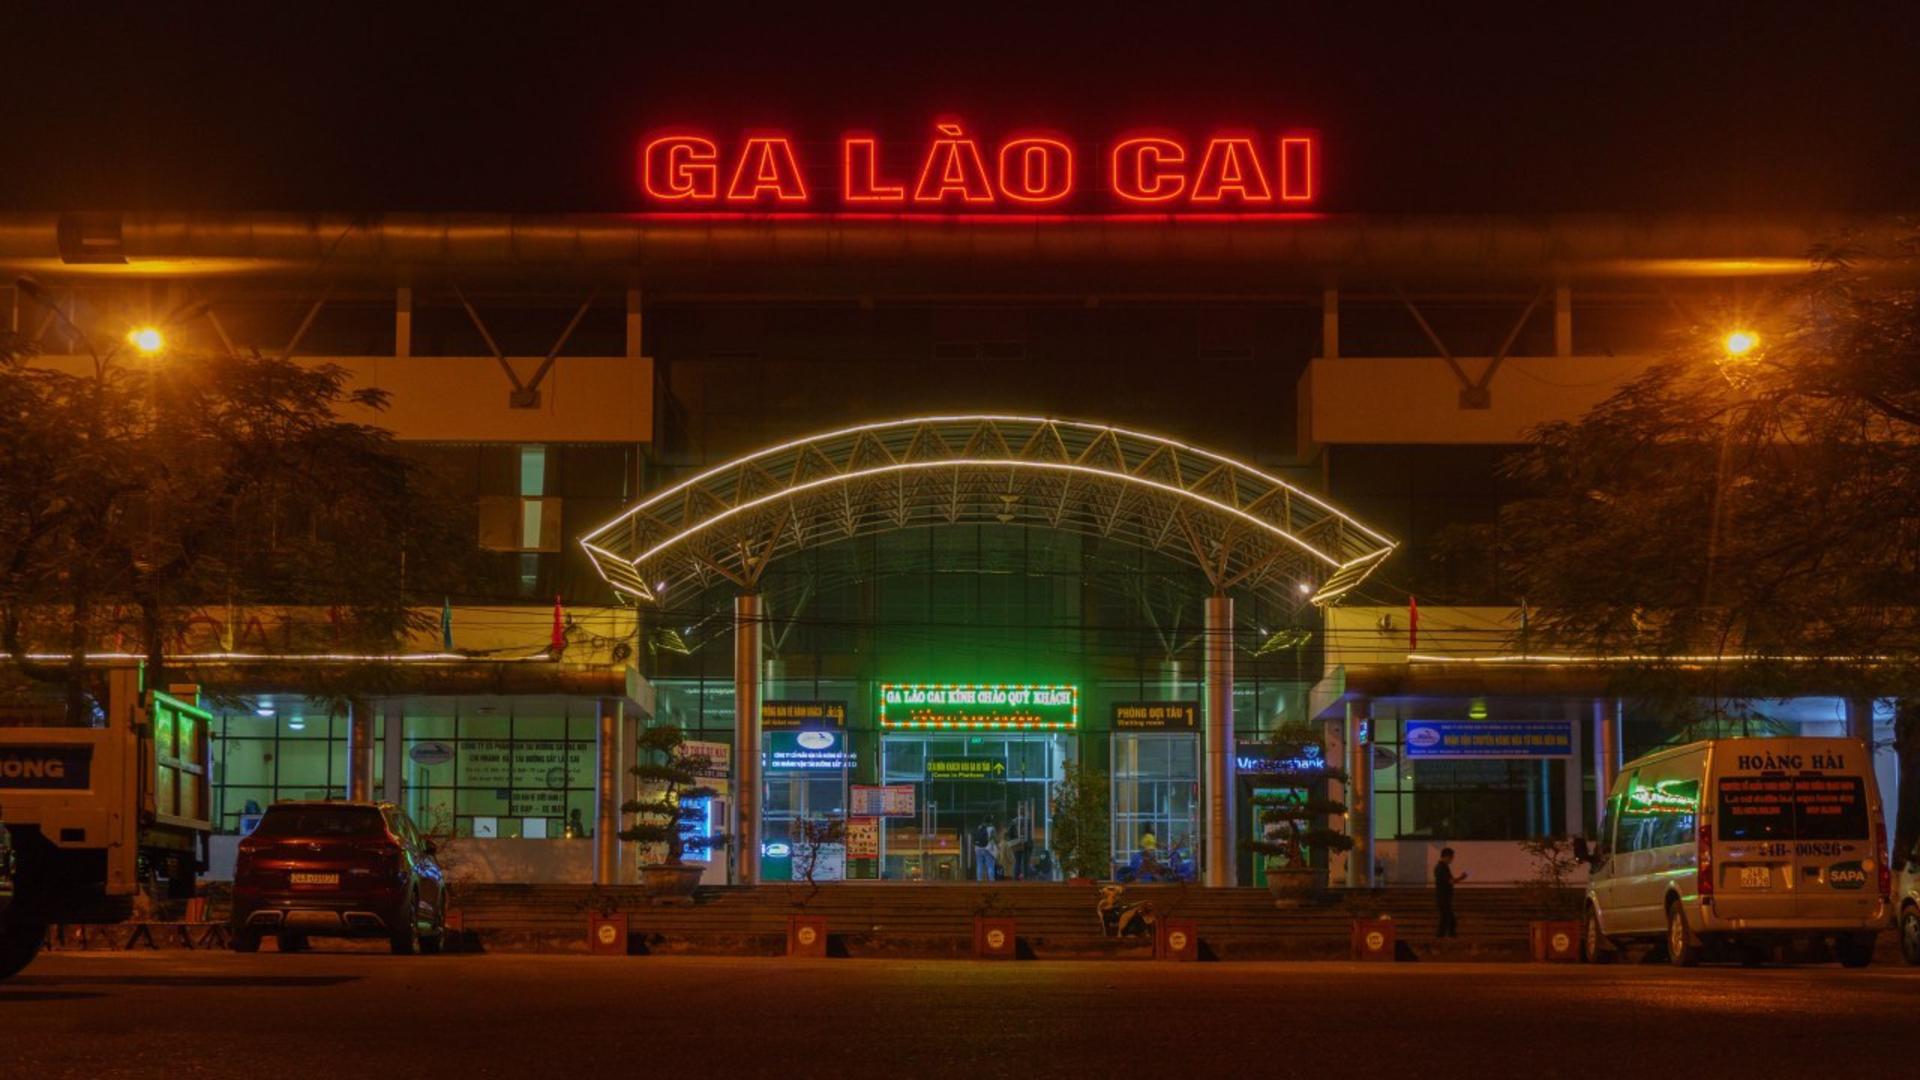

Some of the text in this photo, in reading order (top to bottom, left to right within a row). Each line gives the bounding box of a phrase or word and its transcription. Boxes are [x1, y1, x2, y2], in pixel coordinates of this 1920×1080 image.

[645, 124, 1311, 201] GA LÀO CAI
[886, 690, 902, 704] GA
[903, 688, 926, 704] LÀO
[927, 690, 946, 704] CAI
[947, 687, 976, 704] KÍNH
[977, 688, 1007, 704] CHÀO
[1033, 688, 1072, 705] KHÁCH
[1117, 704, 1147, 718] PHÒNG
[1166, 704, 1183, 718] TÀU
[1185, 707, 1193, 727] 1
[1237, 756, 1325, 770] Vietbank
[1738, 750, 1802, 770] HOÀNG
[1830, 870, 1865, 881] SAPA
